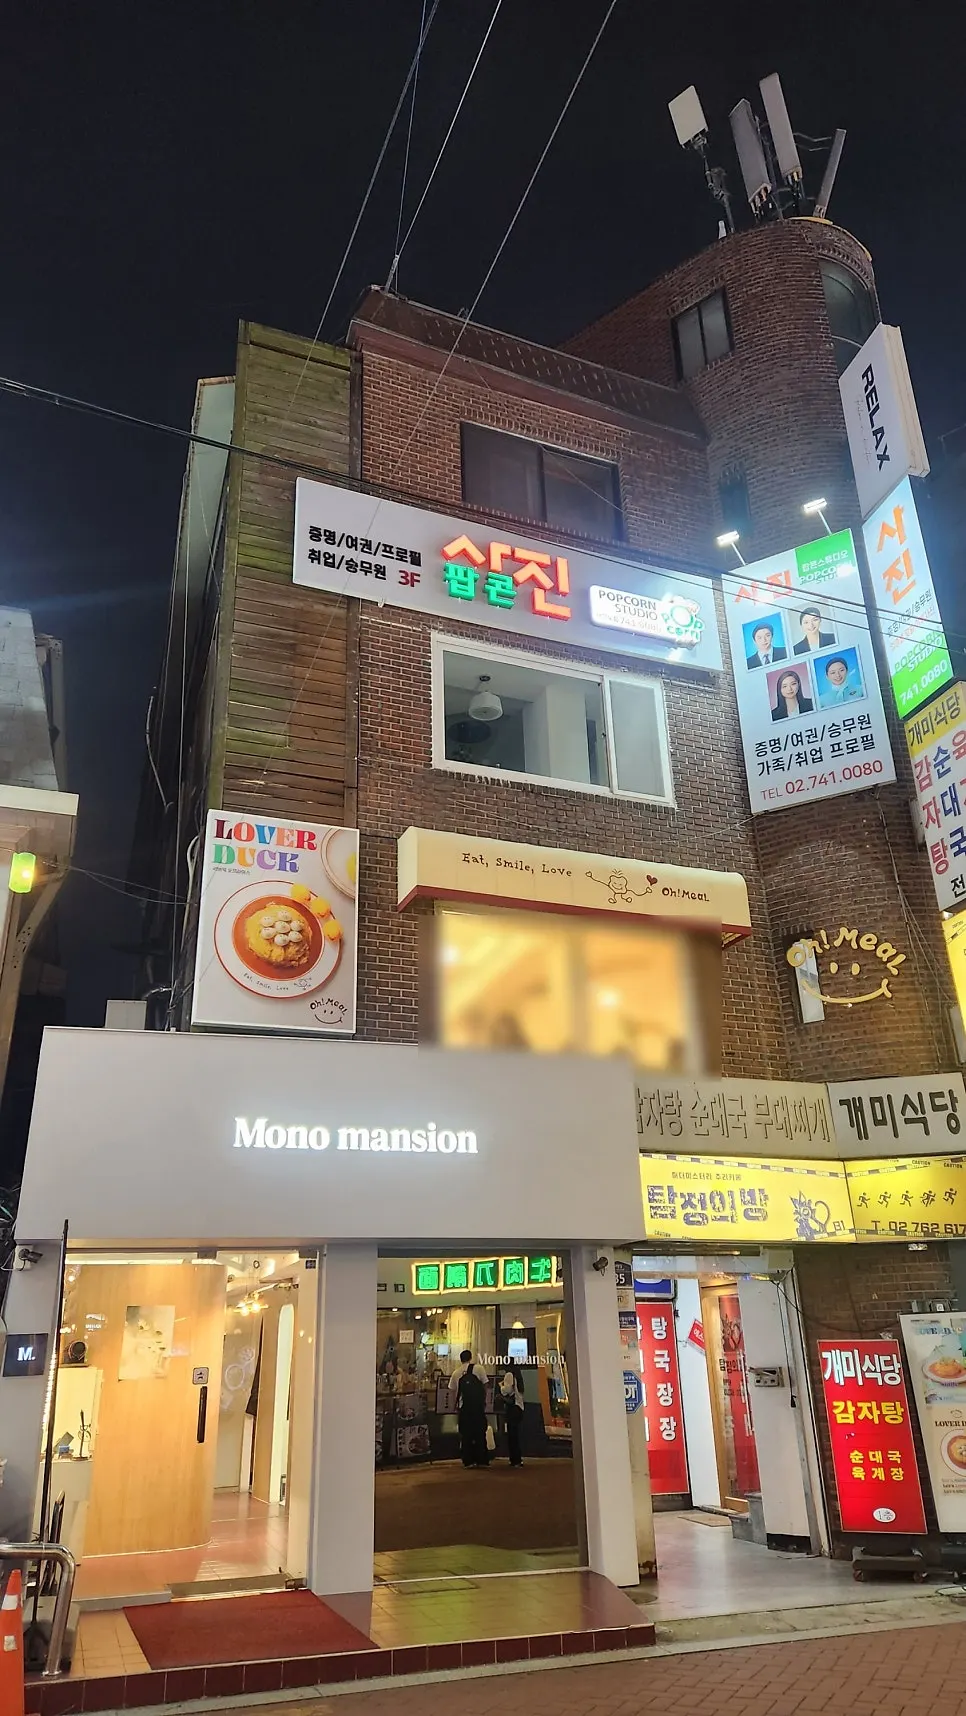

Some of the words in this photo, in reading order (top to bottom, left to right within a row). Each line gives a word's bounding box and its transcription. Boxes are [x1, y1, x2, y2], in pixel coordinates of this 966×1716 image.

[862, 363, 890, 471] RELAX
[309, 525, 422, 567] 증명/여권/프로필
[877, 504, 916, 605] 사진
[308, 548, 387, 580] 취업/승무원
[398, 569, 421, 587] 3F
[443, 562, 517, 609] 팝콘
[598, 589, 656, 611] POPCORN
[615, 603, 658, 621] STUDIO
[901, 660, 948, 705] 741.0080
[755, 713, 872, 758] 증명/여권/승무원
[908, 691, 960, 746] 개미식당
[757, 747, 824, 777] 가족/취업
[830, 733, 876, 759] 프로필
[760, 787, 783, 800] TEL
[785, 759, 883, 795] 02.741.0080
[214, 818, 318, 850] LOVER
[212, 843, 299, 873] DUCK
[462, 853, 489, 868] Eat,
[496, 858, 534, 874] Smile,
[542, 864, 573, 877] Love
[233, 1116, 330, 1150] Mono
[337, 1121, 478, 1154] mansion
[690, 1091, 748, 1139] 순대국
[755, 1094, 831, 1142] 부대찌개
[839, 1089, 961, 1141] 개미식당
[17, 1347, 36, 1361] M.
[477, 1353, 511, 1366] Mono
[822, 1349, 901, 1386] 개미식당
[832, 1401, 904, 1425] 감자탕
